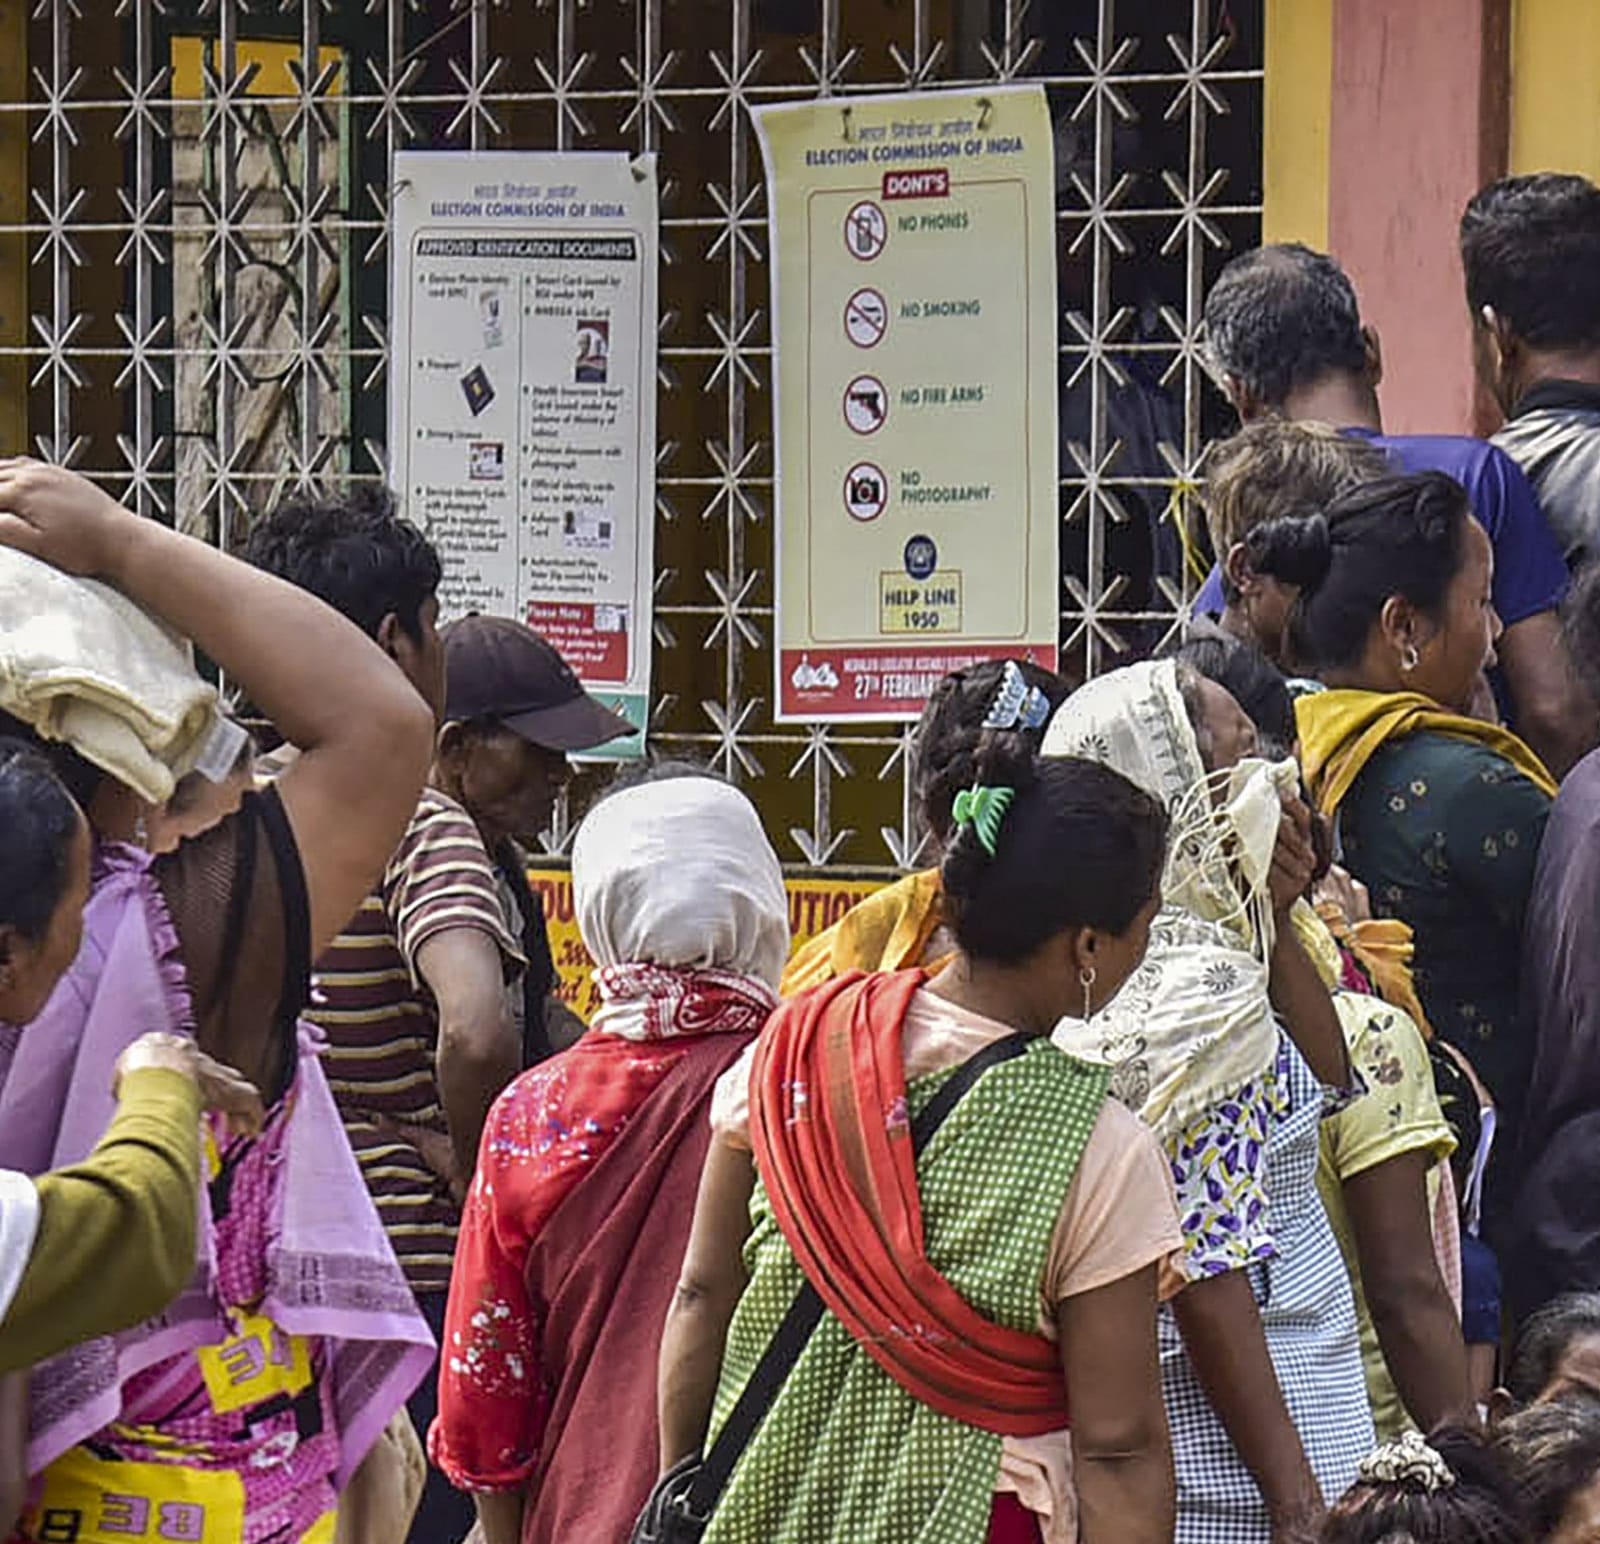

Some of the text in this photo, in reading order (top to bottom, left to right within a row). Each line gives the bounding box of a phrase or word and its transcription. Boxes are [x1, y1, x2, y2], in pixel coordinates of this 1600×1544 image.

[806, 137, 1024, 166] ELECTION COMMISSION OF INDIA
[887, 174, 946, 194] DONT'S
[431, 203, 625, 217] ELECTION COMMISSION OF INDIA
[898, 211, 968, 231] NO PHONES
[900, 300, 981, 318] NO SMOKING
[900, 386, 984, 403] NO FIRE ARMS
[901, 470, 921, 485] NO
[902, 486, 991, 503] PHOTOGRAPHY
[885, 588, 956, 606] HELP LINE
[904, 611, 940, 629] 1950
